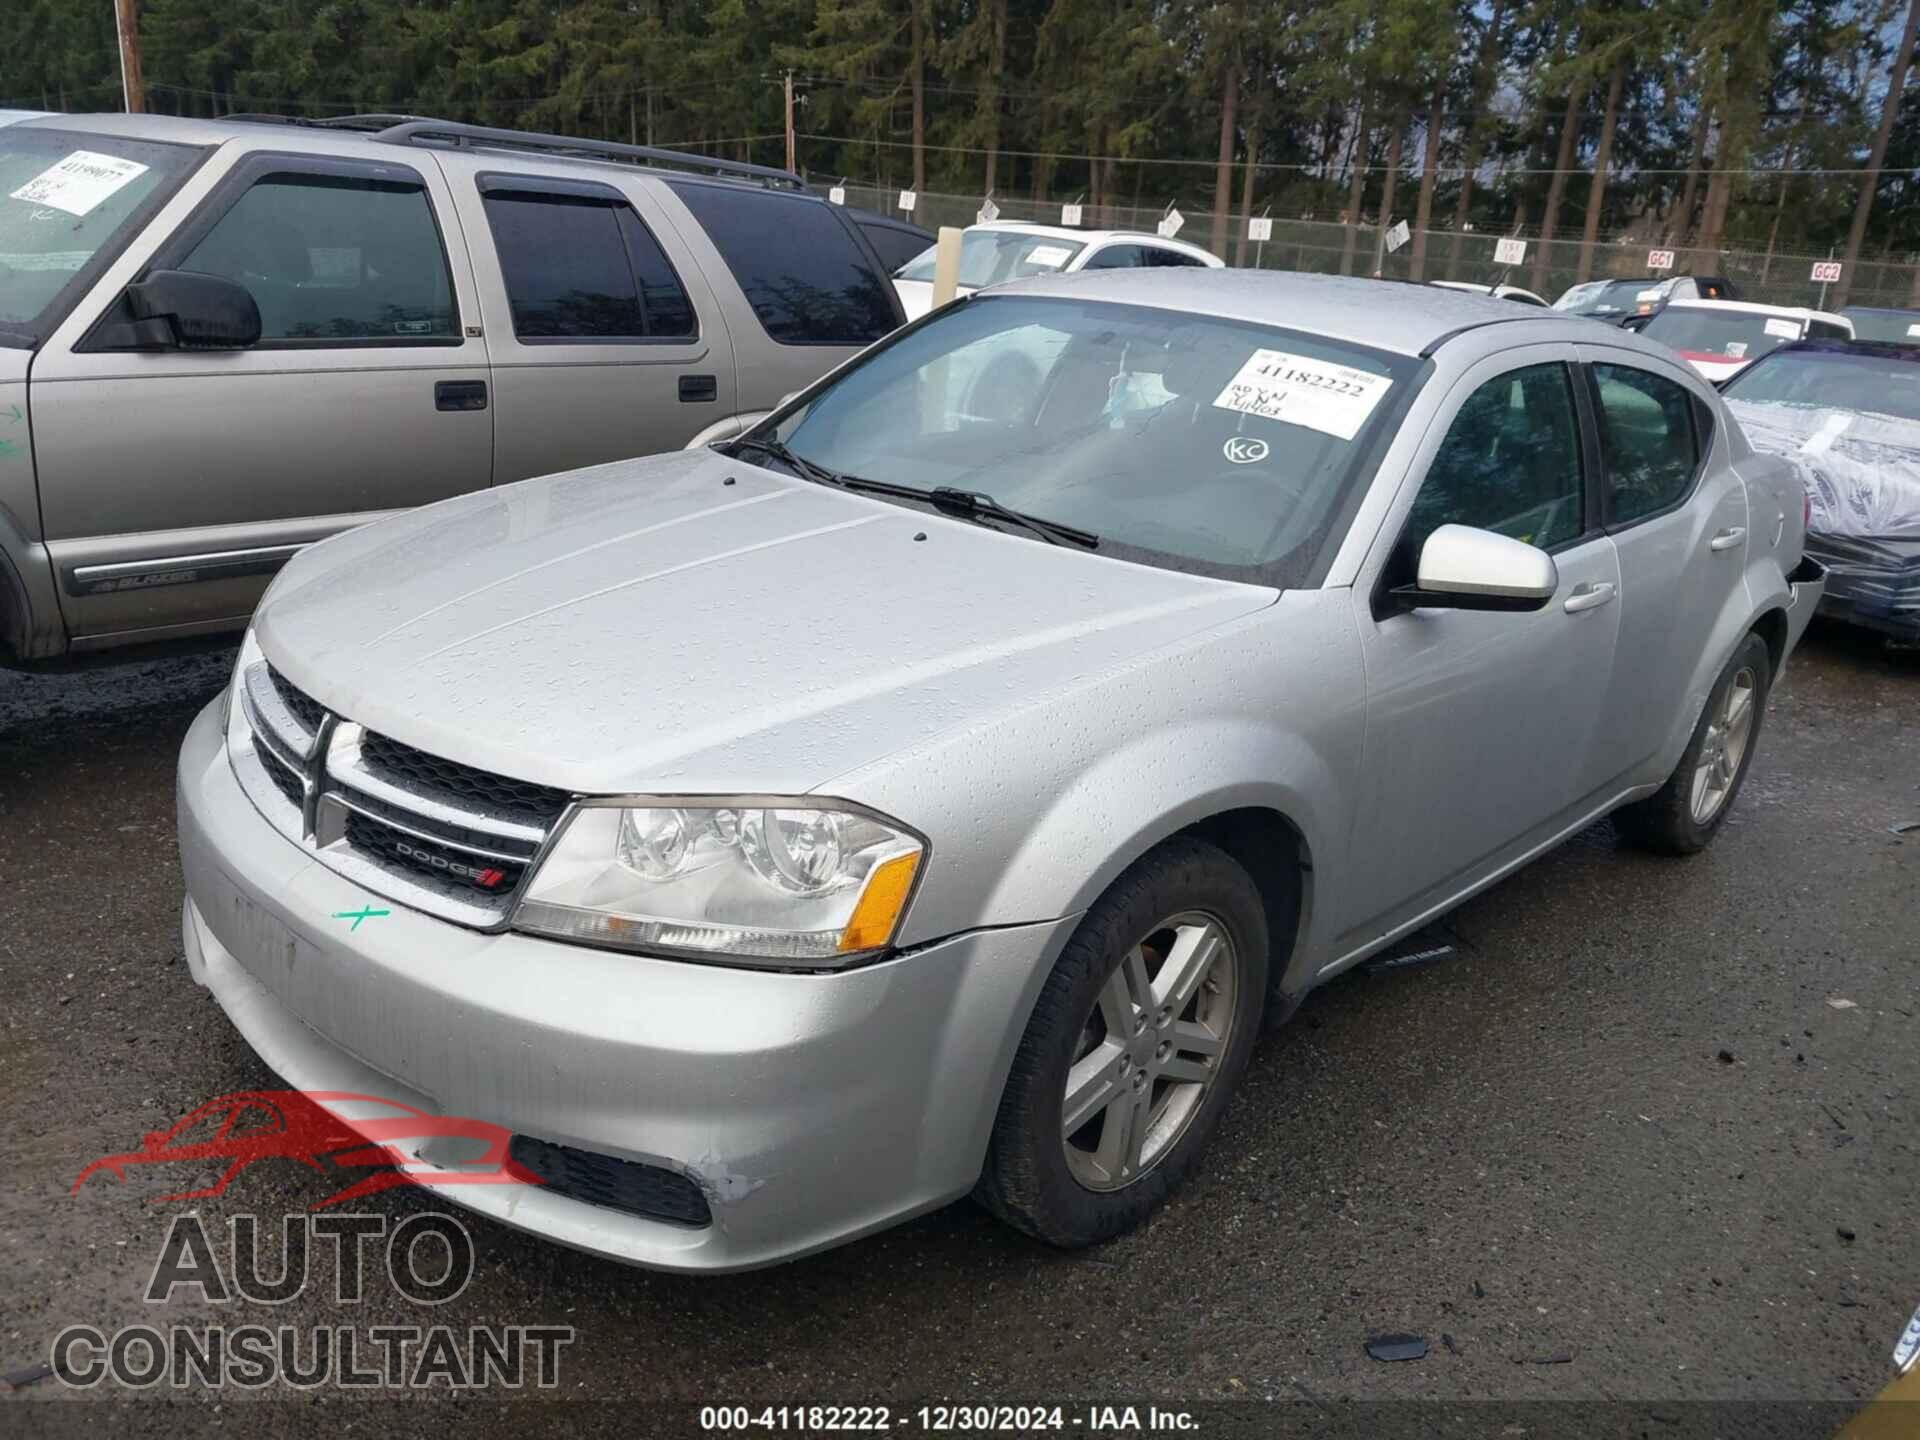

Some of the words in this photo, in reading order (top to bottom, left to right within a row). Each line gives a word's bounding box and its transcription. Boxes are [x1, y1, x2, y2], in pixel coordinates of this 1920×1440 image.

[1649, 252, 1672, 267] GC1
[1814, 264, 1839, 279] GC2
[1256, 364, 1365, 398] 41182222
[1229, 439, 1262, 460] KC
[396, 842, 487, 881] DODGE
